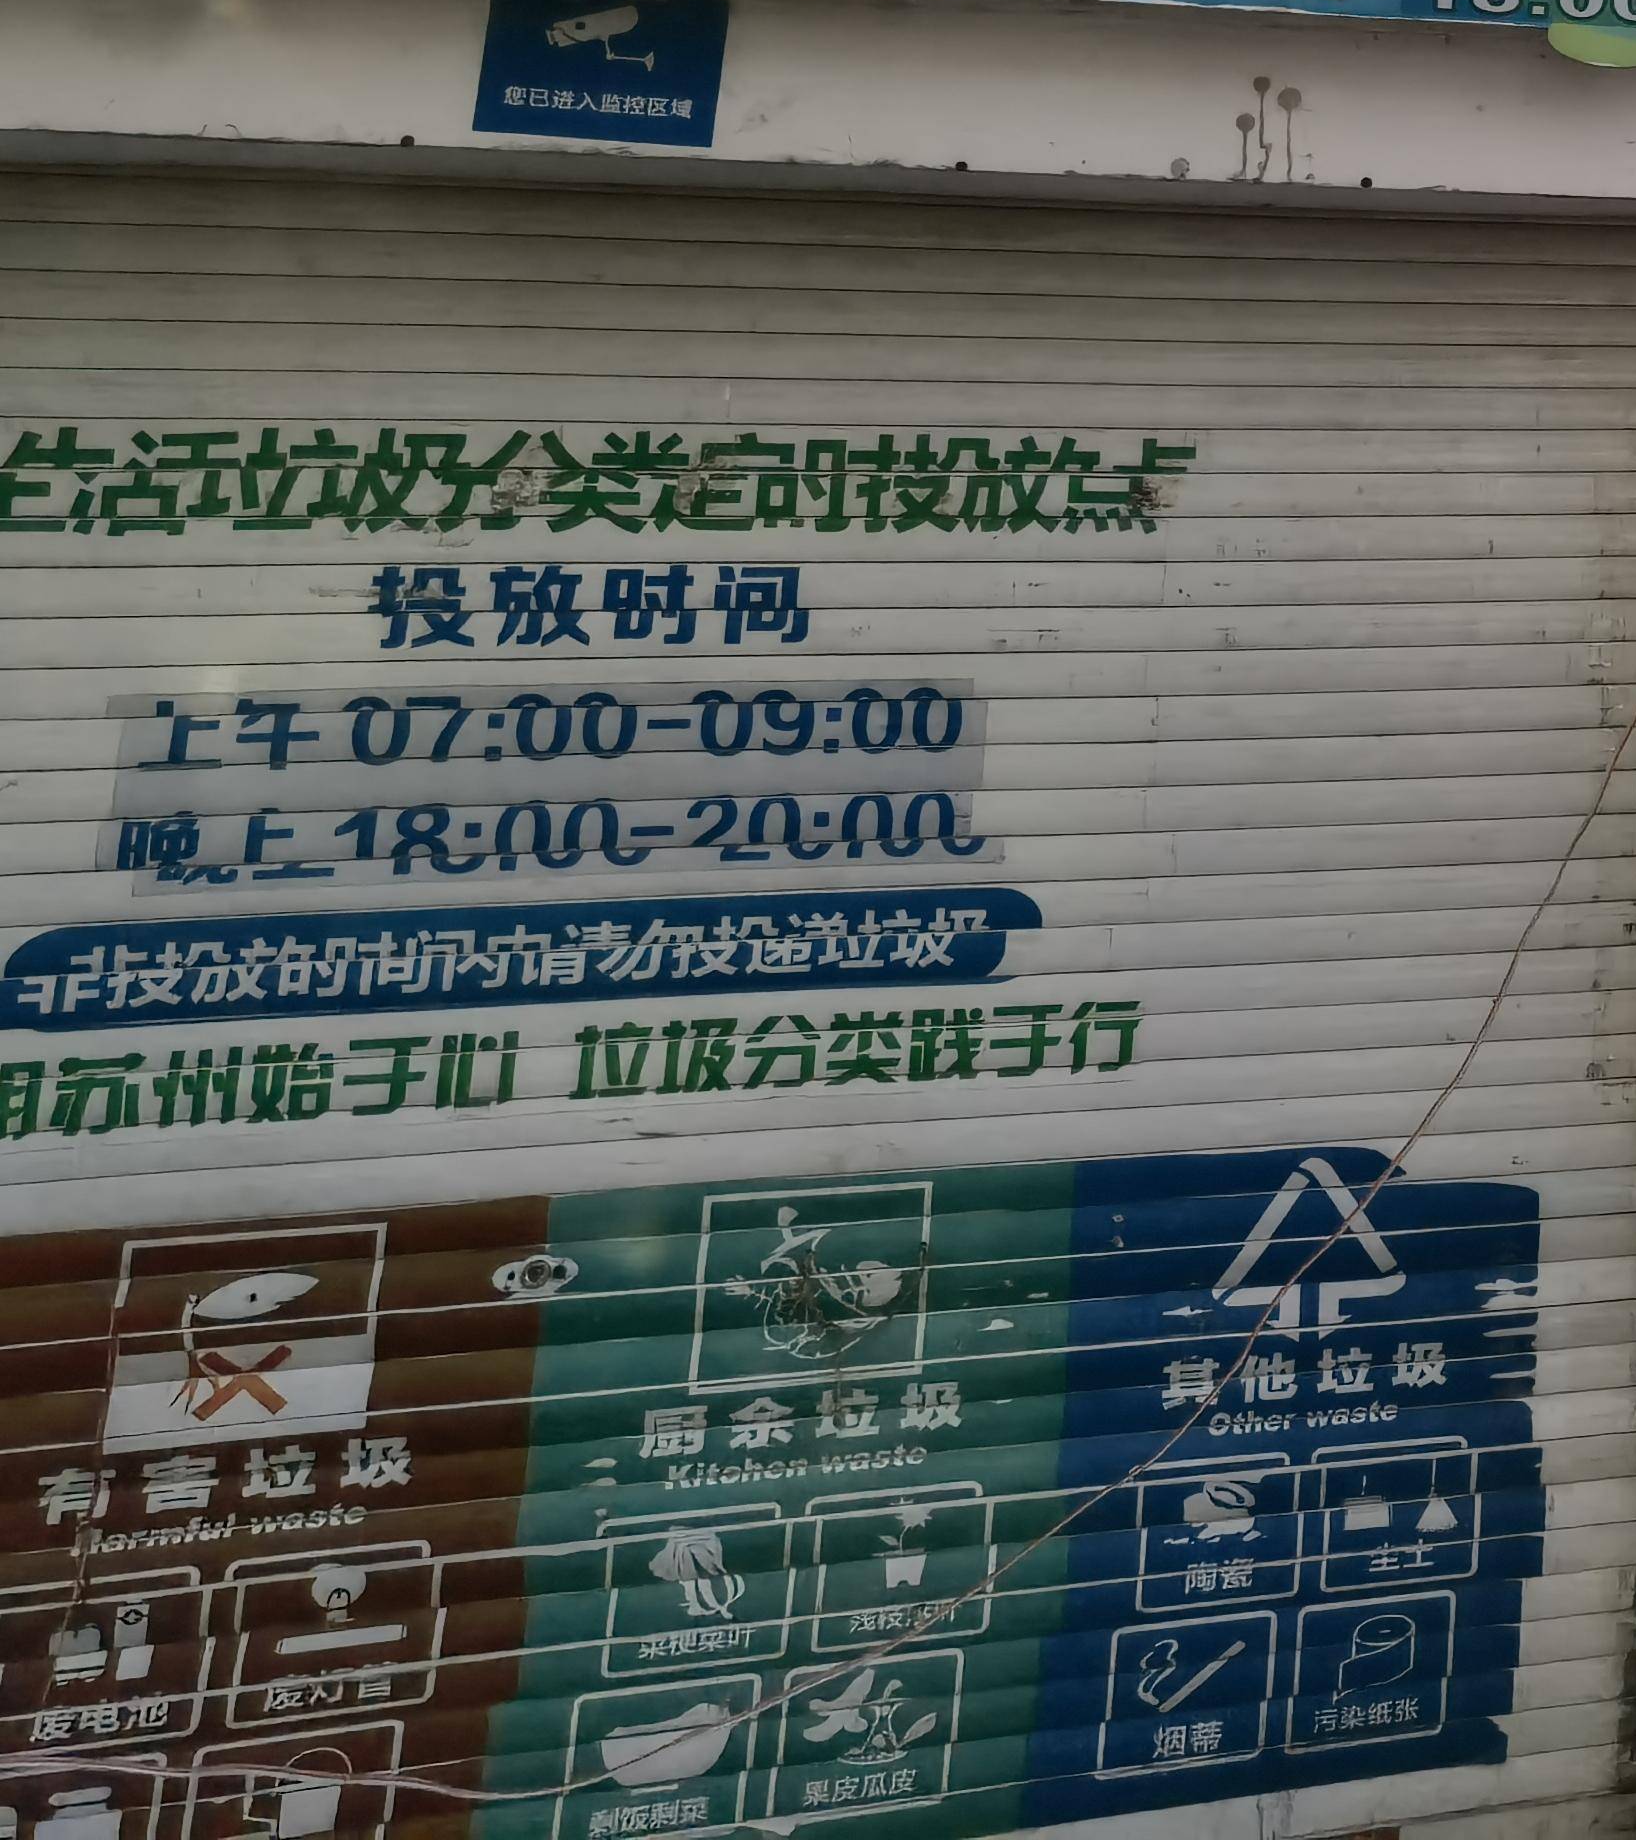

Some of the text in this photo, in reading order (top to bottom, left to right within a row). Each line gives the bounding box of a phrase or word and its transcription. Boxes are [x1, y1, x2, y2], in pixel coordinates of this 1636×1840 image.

[504, 85, 694, 120] 您已进入监控区域
[0, 426, 1197, 536] 生活垃圾分类定时投放点
[368, 564, 810, 648] 投放时间
[138, 685, 963, 770] 上午 07:00-09:00
[117, 791, 987, 886] 晚上 18:00-20:00
[569, 1000, 1141, 1100] 垃圾分类践于行
[1162, 1341, 1448, 1411] 其他垃圾
[639, 1381, 963, 1459] 厨余垃圾
[1209, 1399, 1399, 1437] Other waste
[38, 1435, 413, 1526] 有害垃圾
[820, 1442, 928, 1475] waste
[251, 1501, 368, 1533] waste
[1184, 1557, 1255, 1595] 陶瓷
[1152, 1721, 1225, 1759] 烟蒂
[1313, 1696, 1419, 1734] 污染纸张
[802, 1768, 918, 1807] 果皮瓜皮
